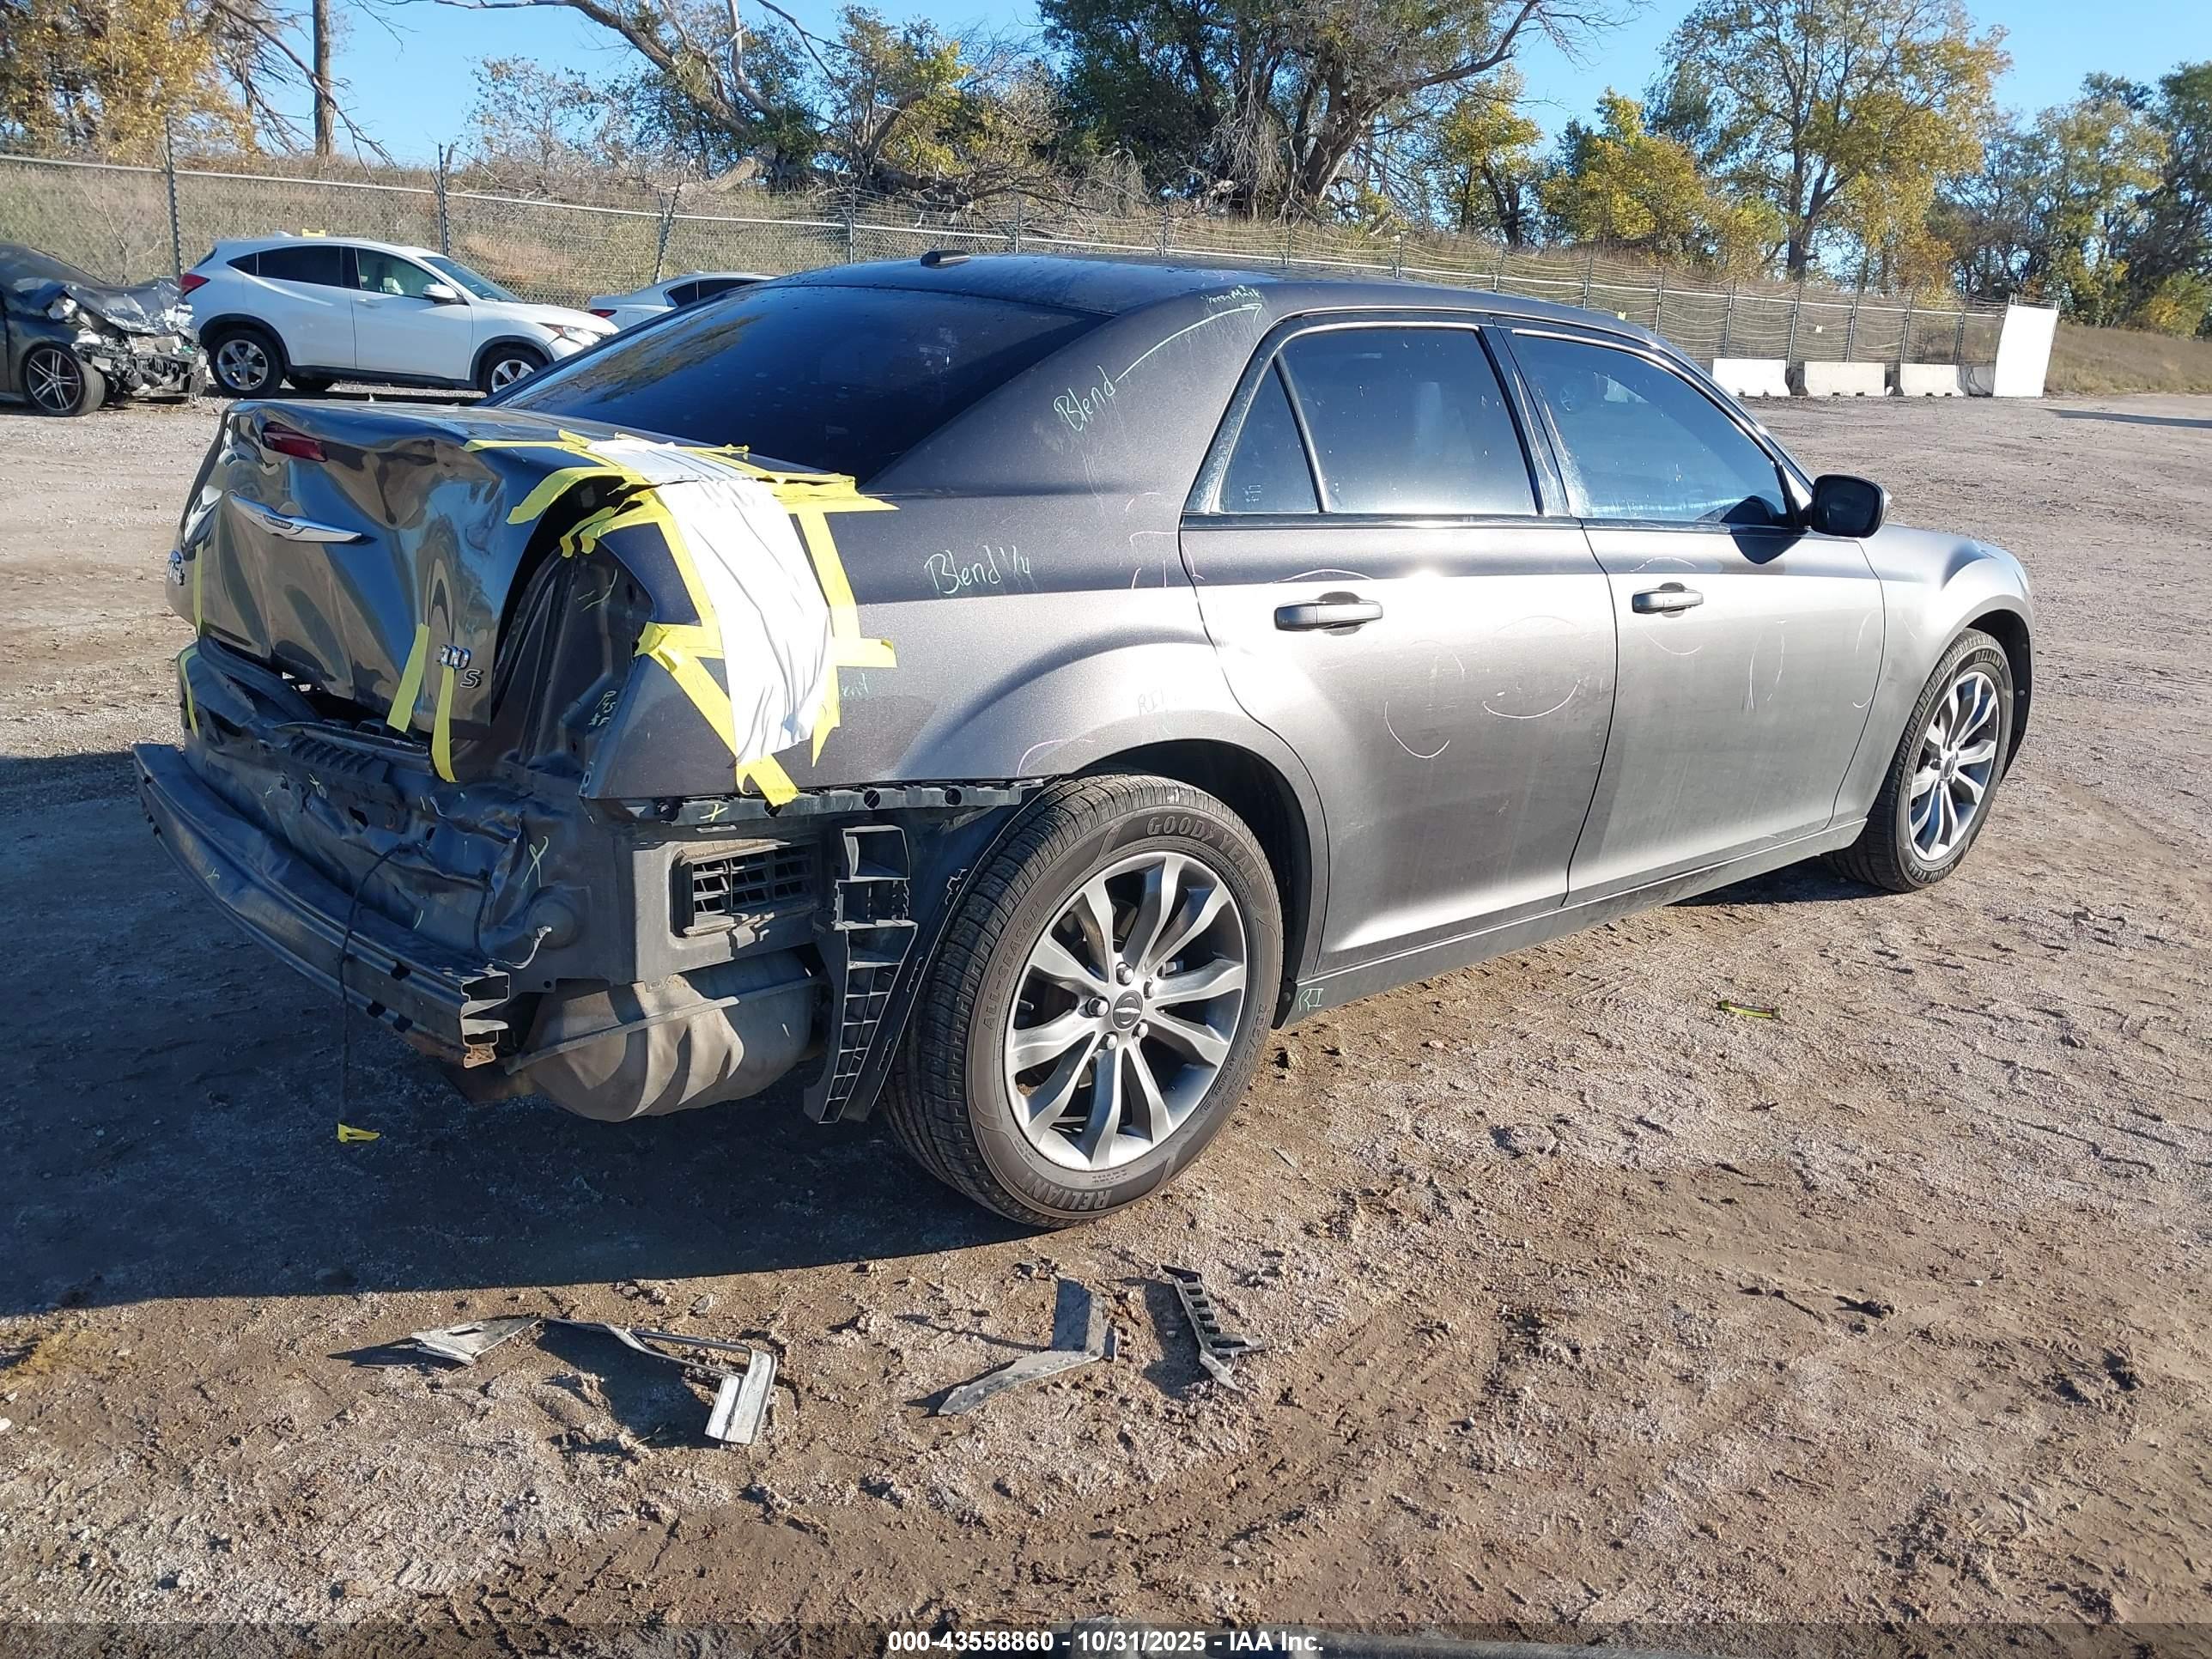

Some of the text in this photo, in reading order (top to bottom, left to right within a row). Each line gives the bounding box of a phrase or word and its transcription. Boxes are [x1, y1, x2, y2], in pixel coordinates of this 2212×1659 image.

[1053, 364, 1116, 431] Blend
[924, 545, 1000, 594] Blend
[460, 668, 481, 689] S
[1973, 650, 2005, 671] RELIANT
[1146, 817, 1259, 888] GOODYEAR
[1298, 988, 1324, 1012] RI
[1015, 1171, 1113, 1211] RELIANT
